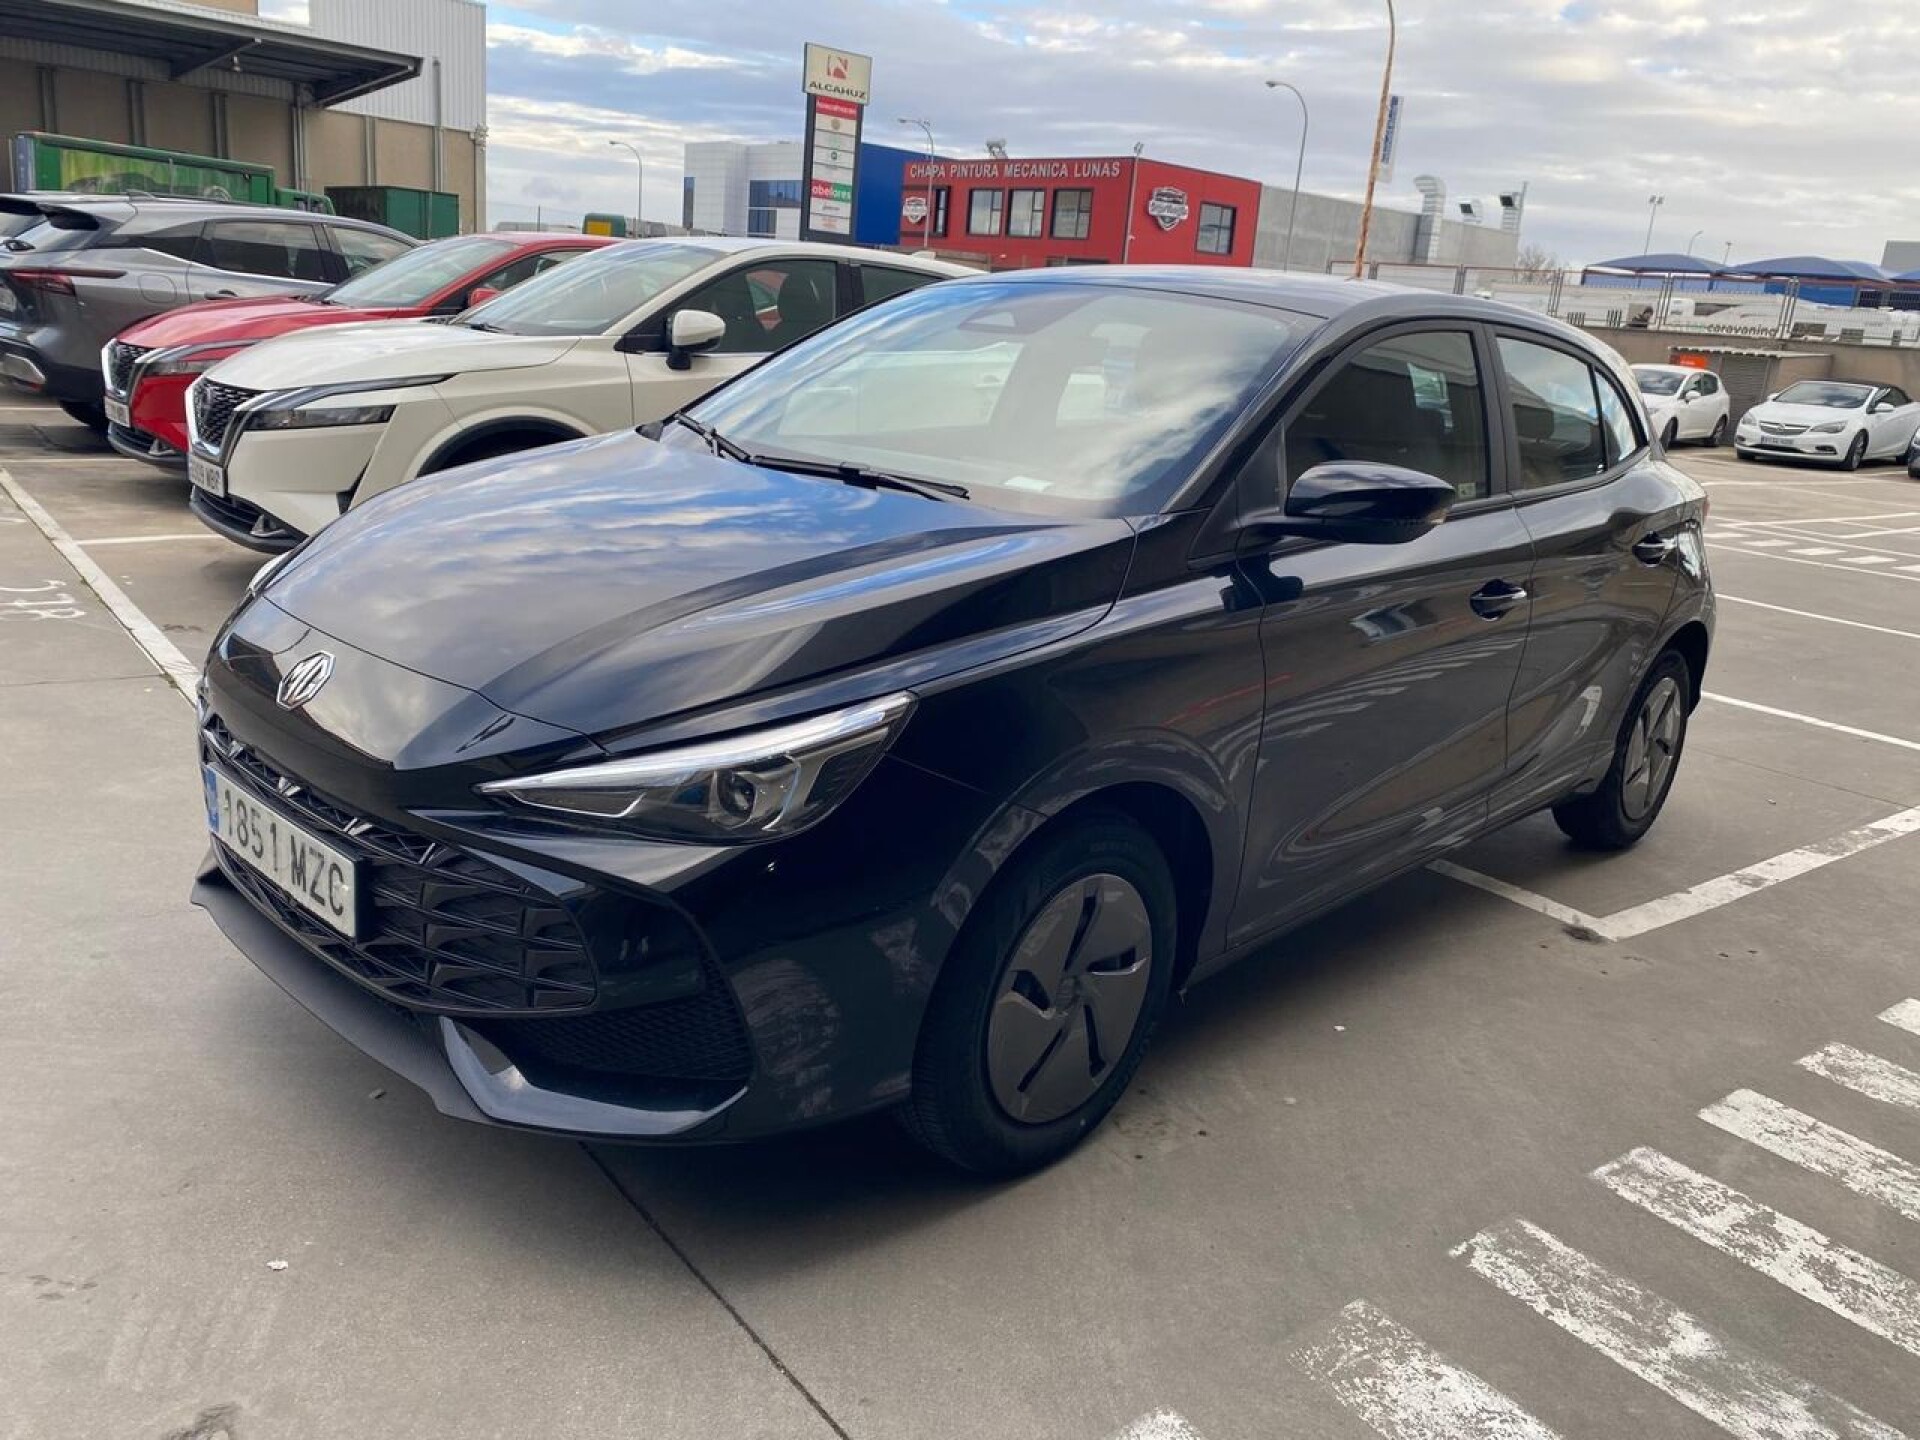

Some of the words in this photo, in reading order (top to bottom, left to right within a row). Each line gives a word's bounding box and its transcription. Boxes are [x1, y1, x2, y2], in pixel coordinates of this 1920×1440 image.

[809, 80, 866, 99] ALCAHUZ
[910, 163, 946, 178] CHAPA
[950, 163, 999, 178] PINTURA
[1003, 162, 1069, 178] MECANICA
[1074, 161, 1120, 178] LUNAS
[279, 654, 332, 706] MG
[223, 788, 279, 873] 1851
[290, 834, 345, 917] MZC
